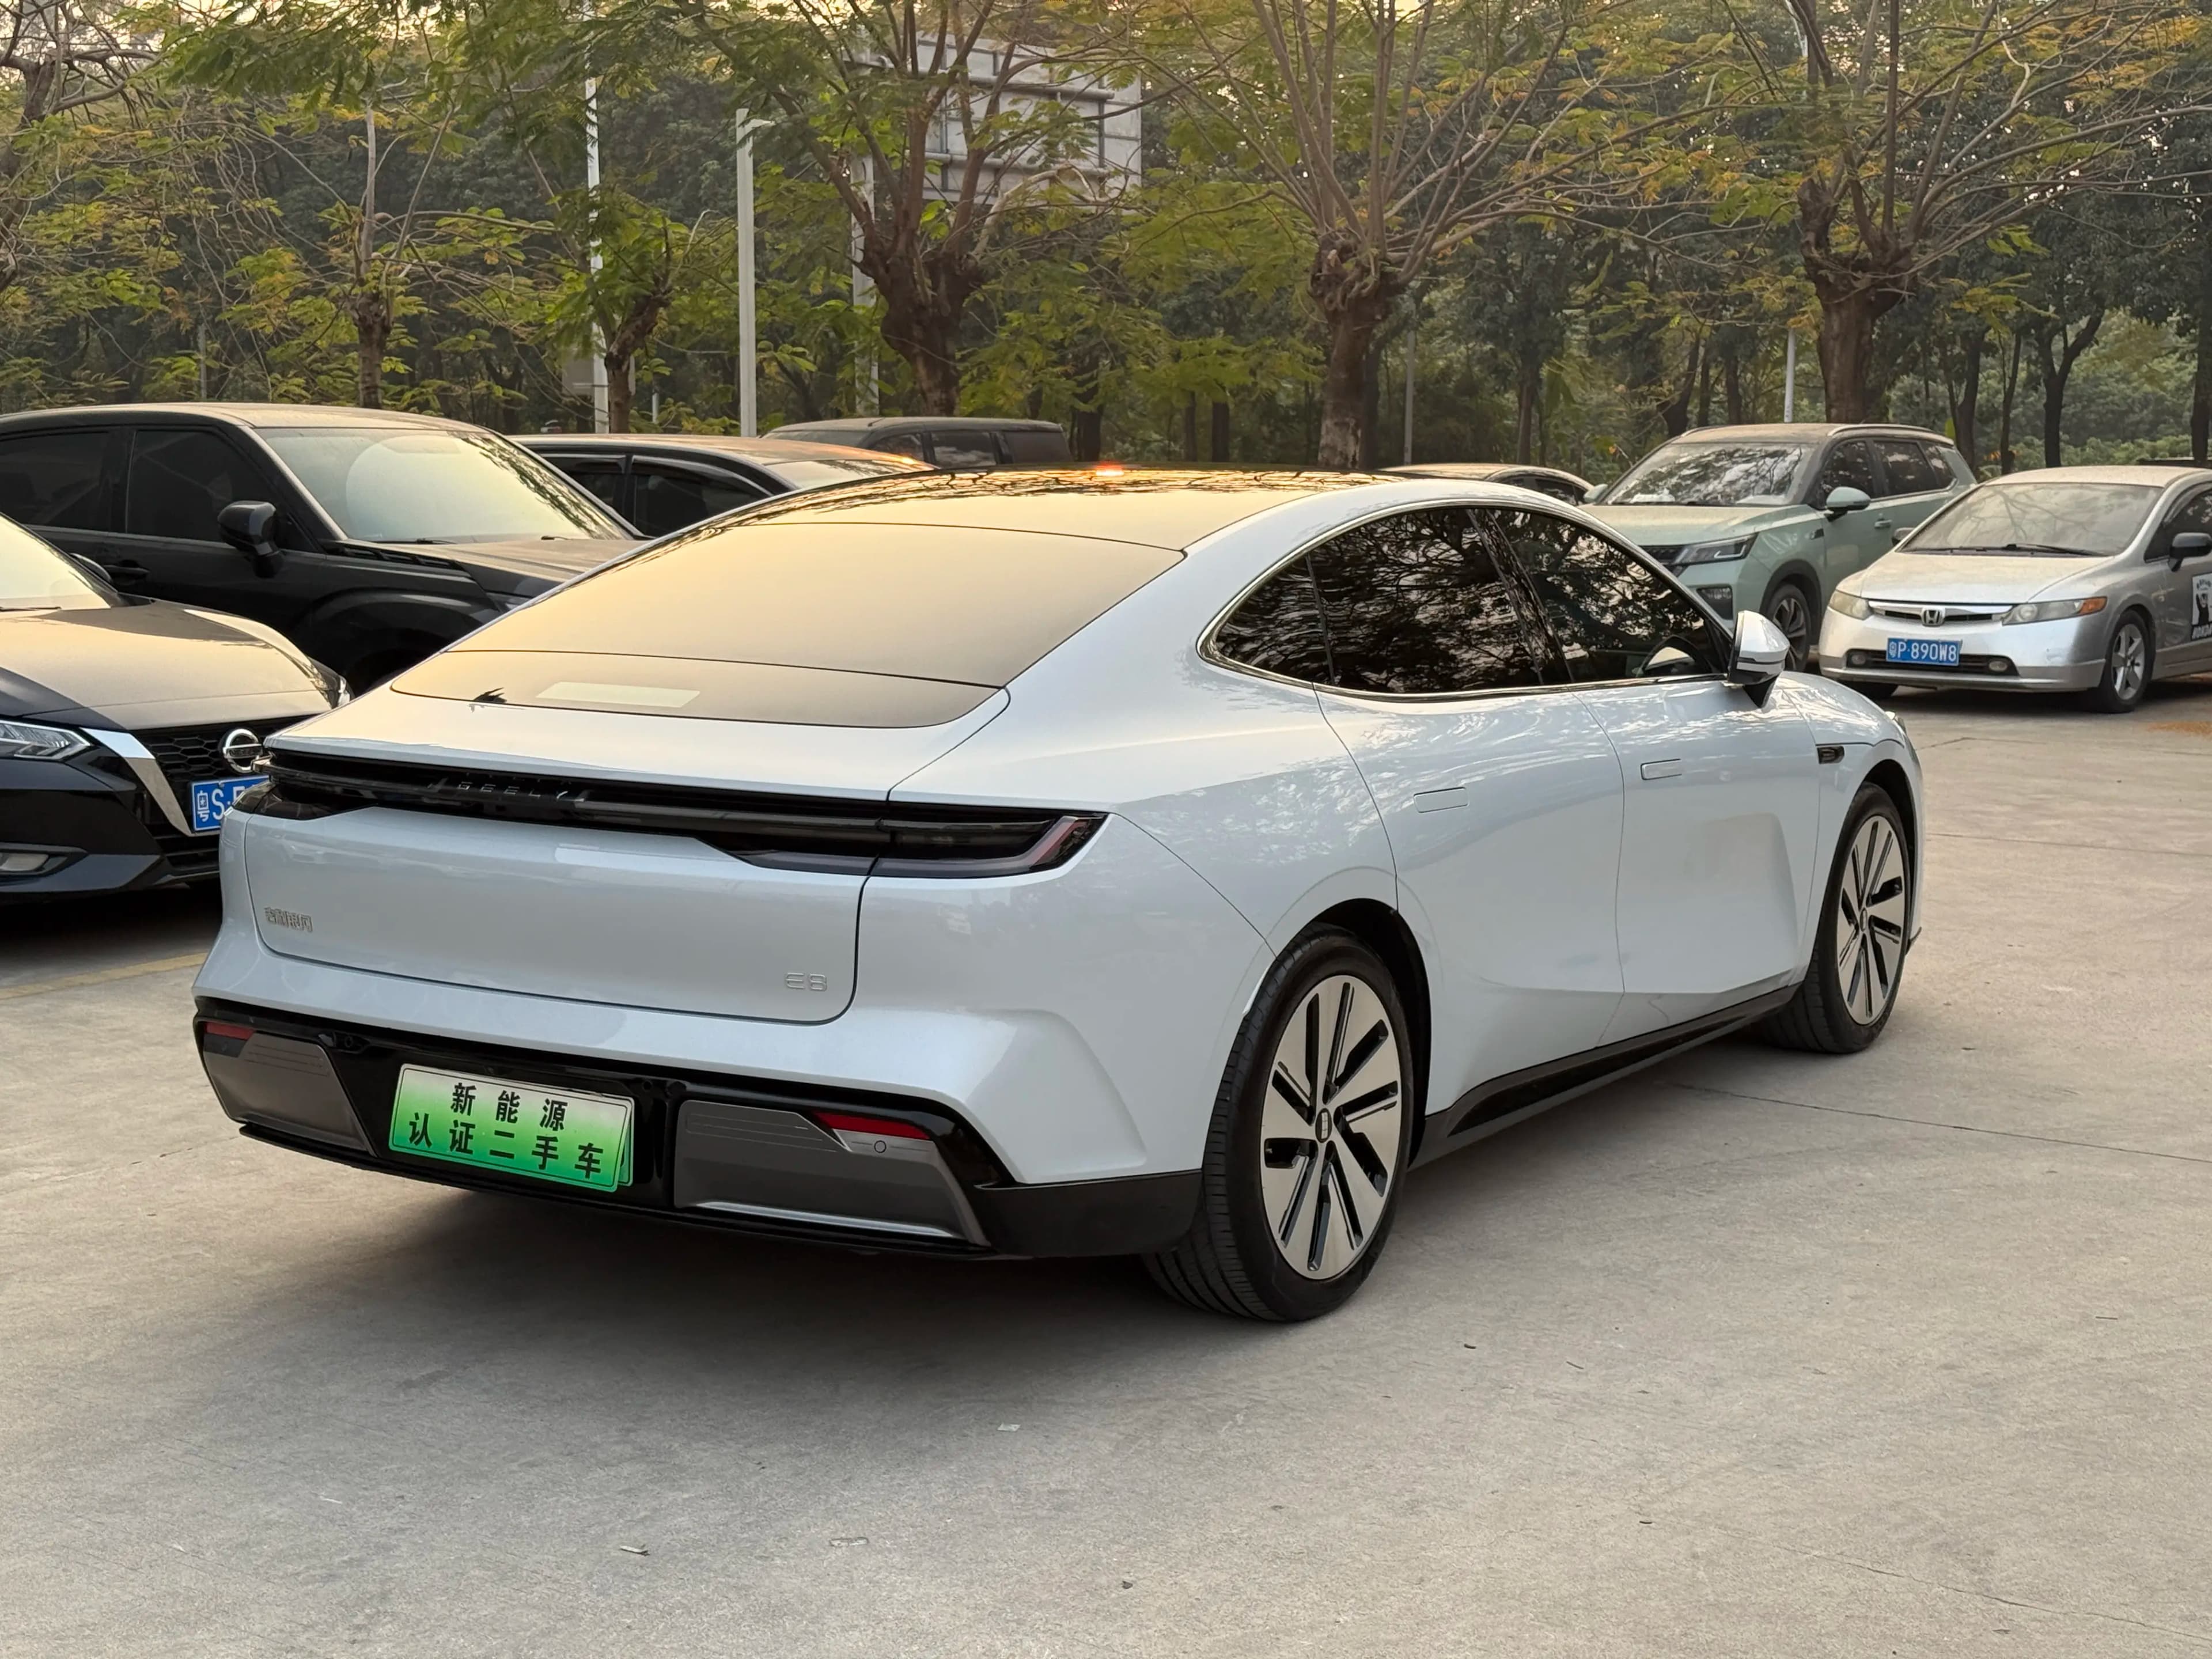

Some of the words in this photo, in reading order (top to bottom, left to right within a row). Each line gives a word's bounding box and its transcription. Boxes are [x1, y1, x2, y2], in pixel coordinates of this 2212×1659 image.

[450, 1082, 569, 1131] 新能源
[408, 1112, 604, 1179] 认证二手车
